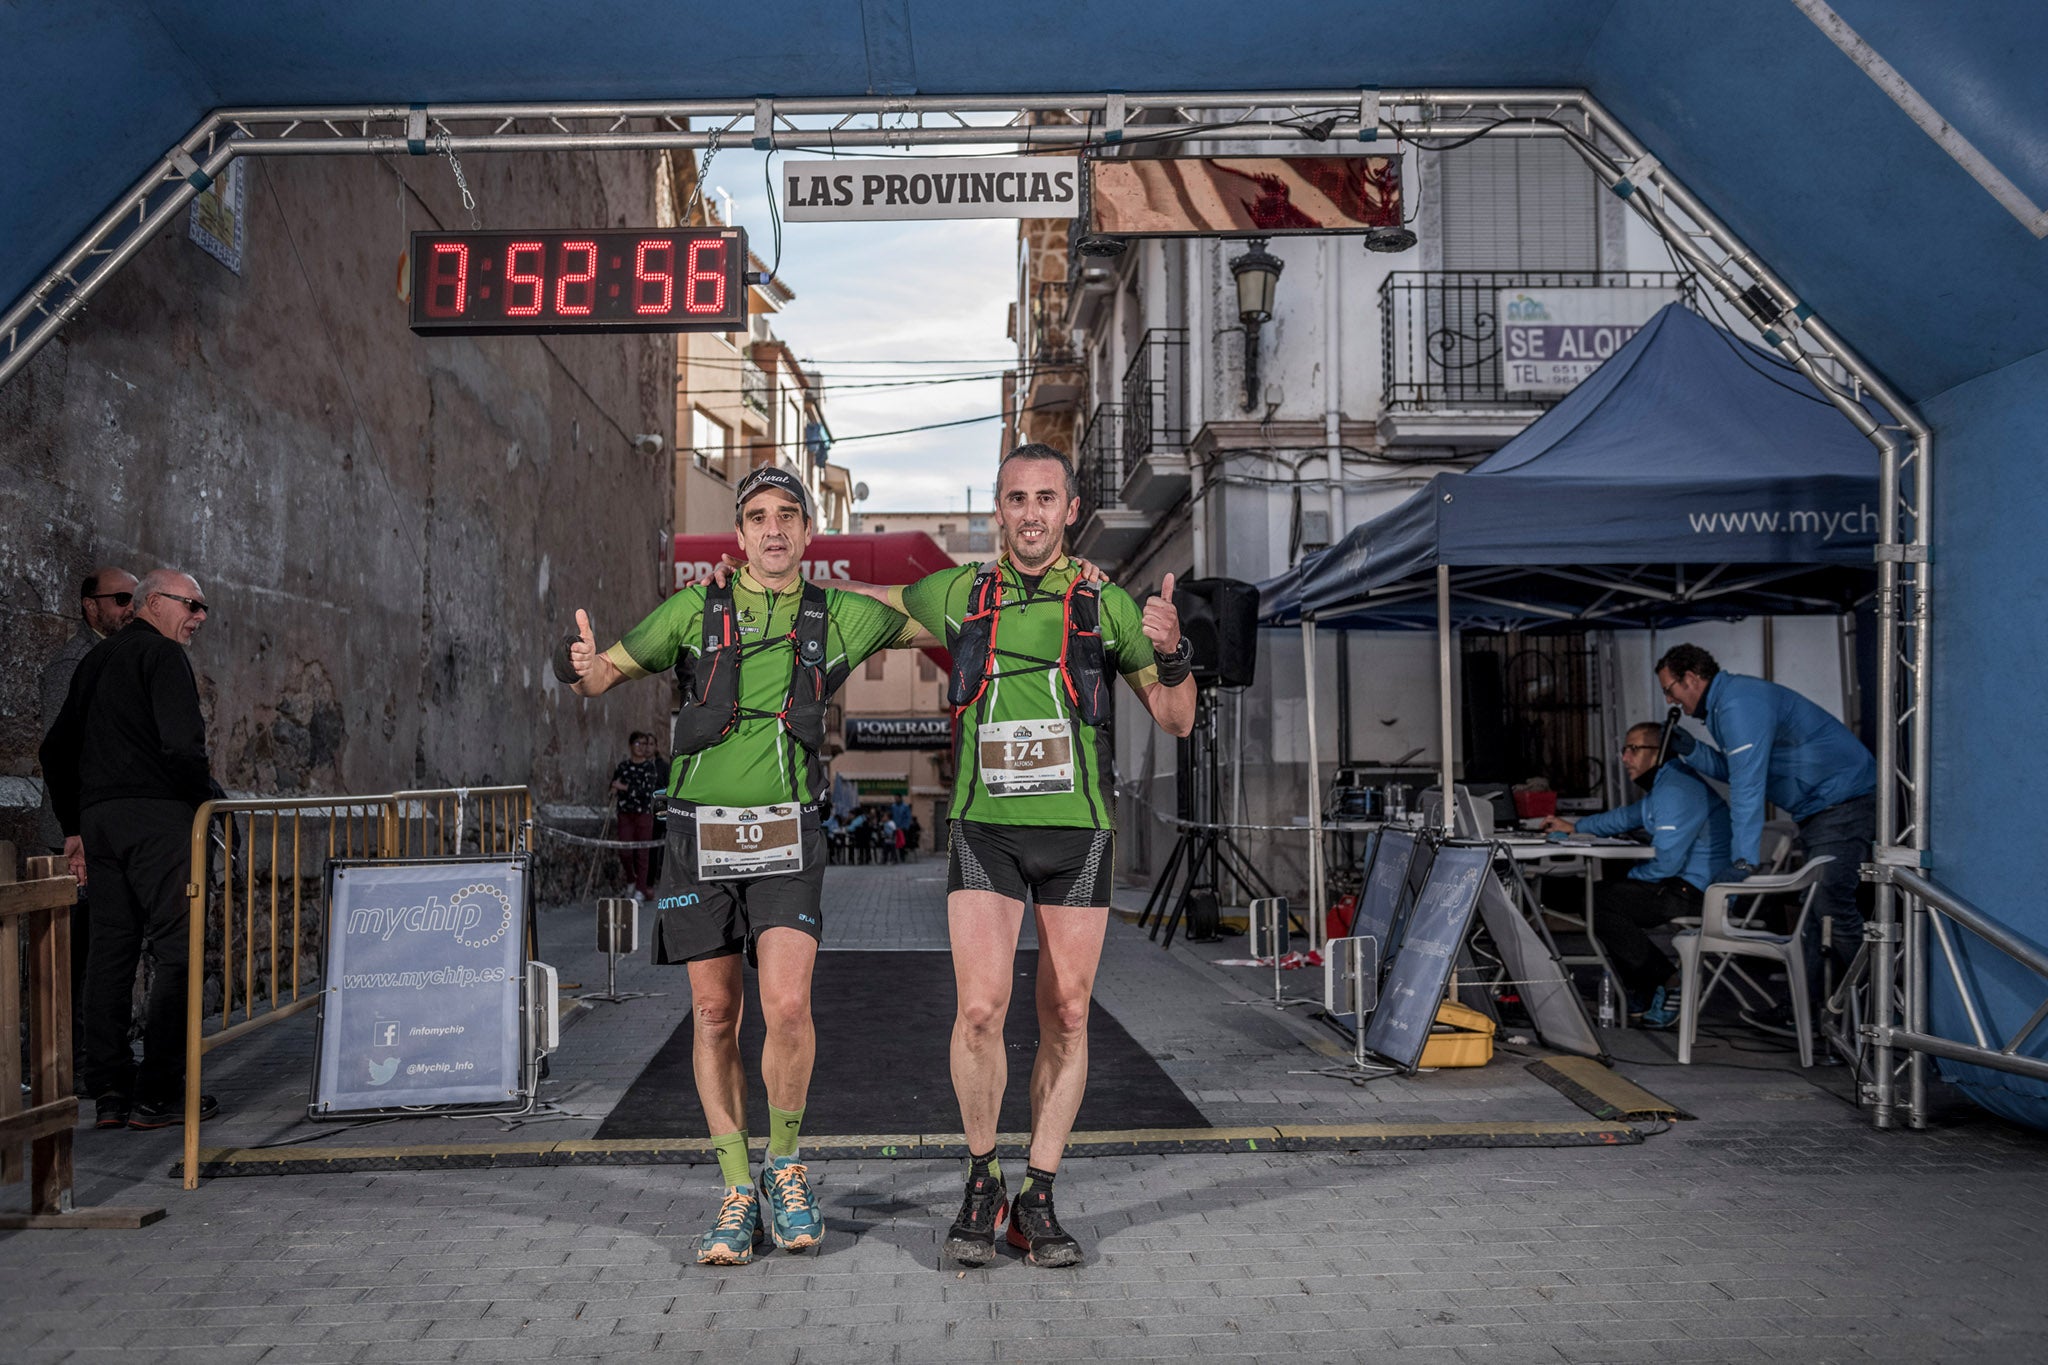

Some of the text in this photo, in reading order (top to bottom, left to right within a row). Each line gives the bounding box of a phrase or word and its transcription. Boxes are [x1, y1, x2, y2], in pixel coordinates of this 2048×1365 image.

[788, 171, 1074, 207] LAS PROVINCIAS
[1510, 328, 1546, 358] SE
[856, 721, 952, 735] POWERADE
[1003, 741, 1046, 762] 174
[735, 824, 764, 844] 10
[347, 896, 483, 942] mychip
[343, 963, 506, 991] www.mychip.es
